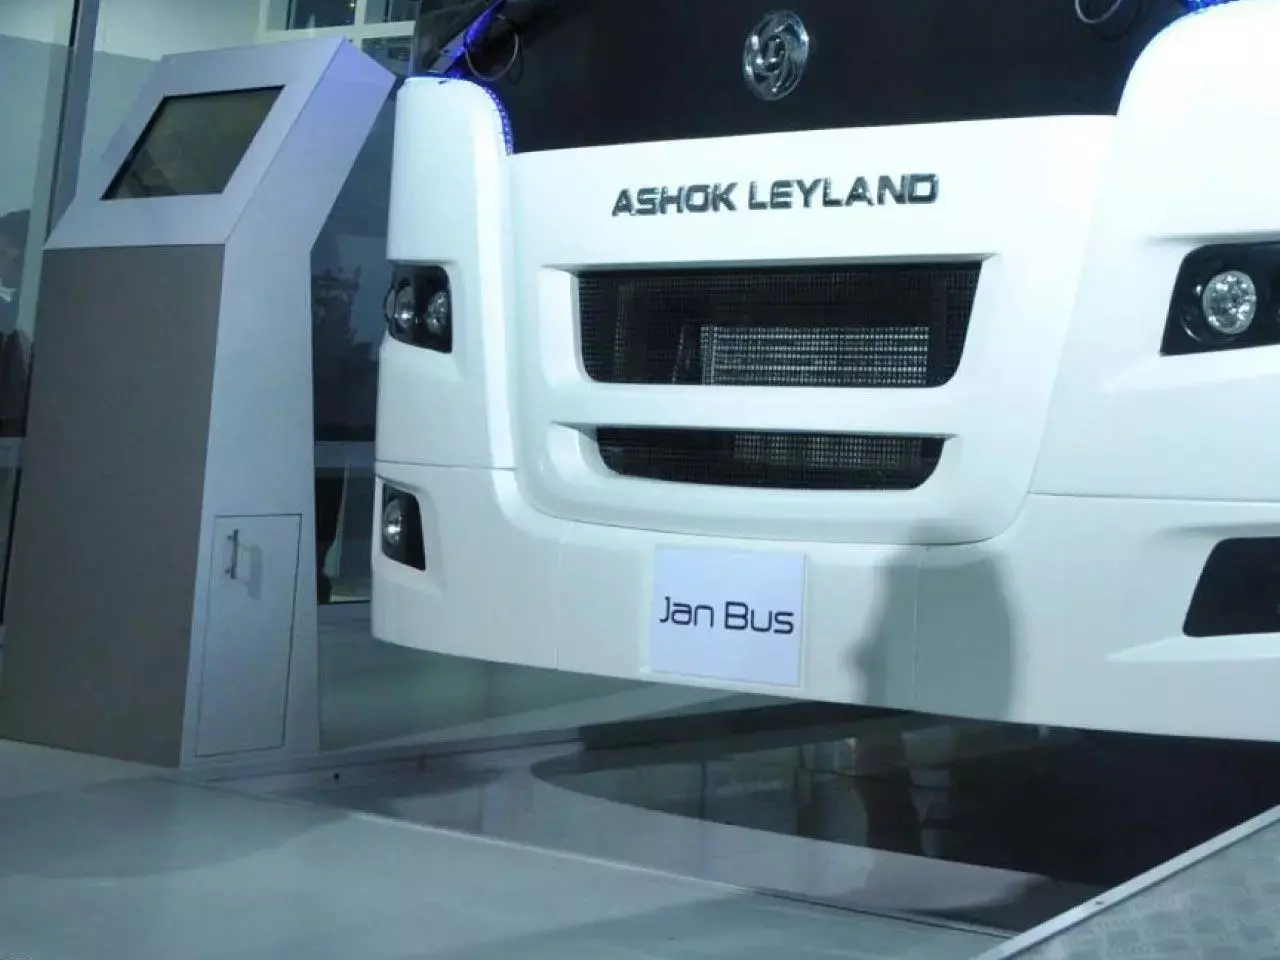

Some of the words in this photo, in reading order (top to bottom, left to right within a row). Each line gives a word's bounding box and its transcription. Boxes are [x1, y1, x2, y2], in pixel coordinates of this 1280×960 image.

[611, 181, 739, 218] ASHOK
[747, 172, 941, 211] LEYLAND
[659, 595, 715, 629] Jan
[723, 599, 795, 635] Bus
